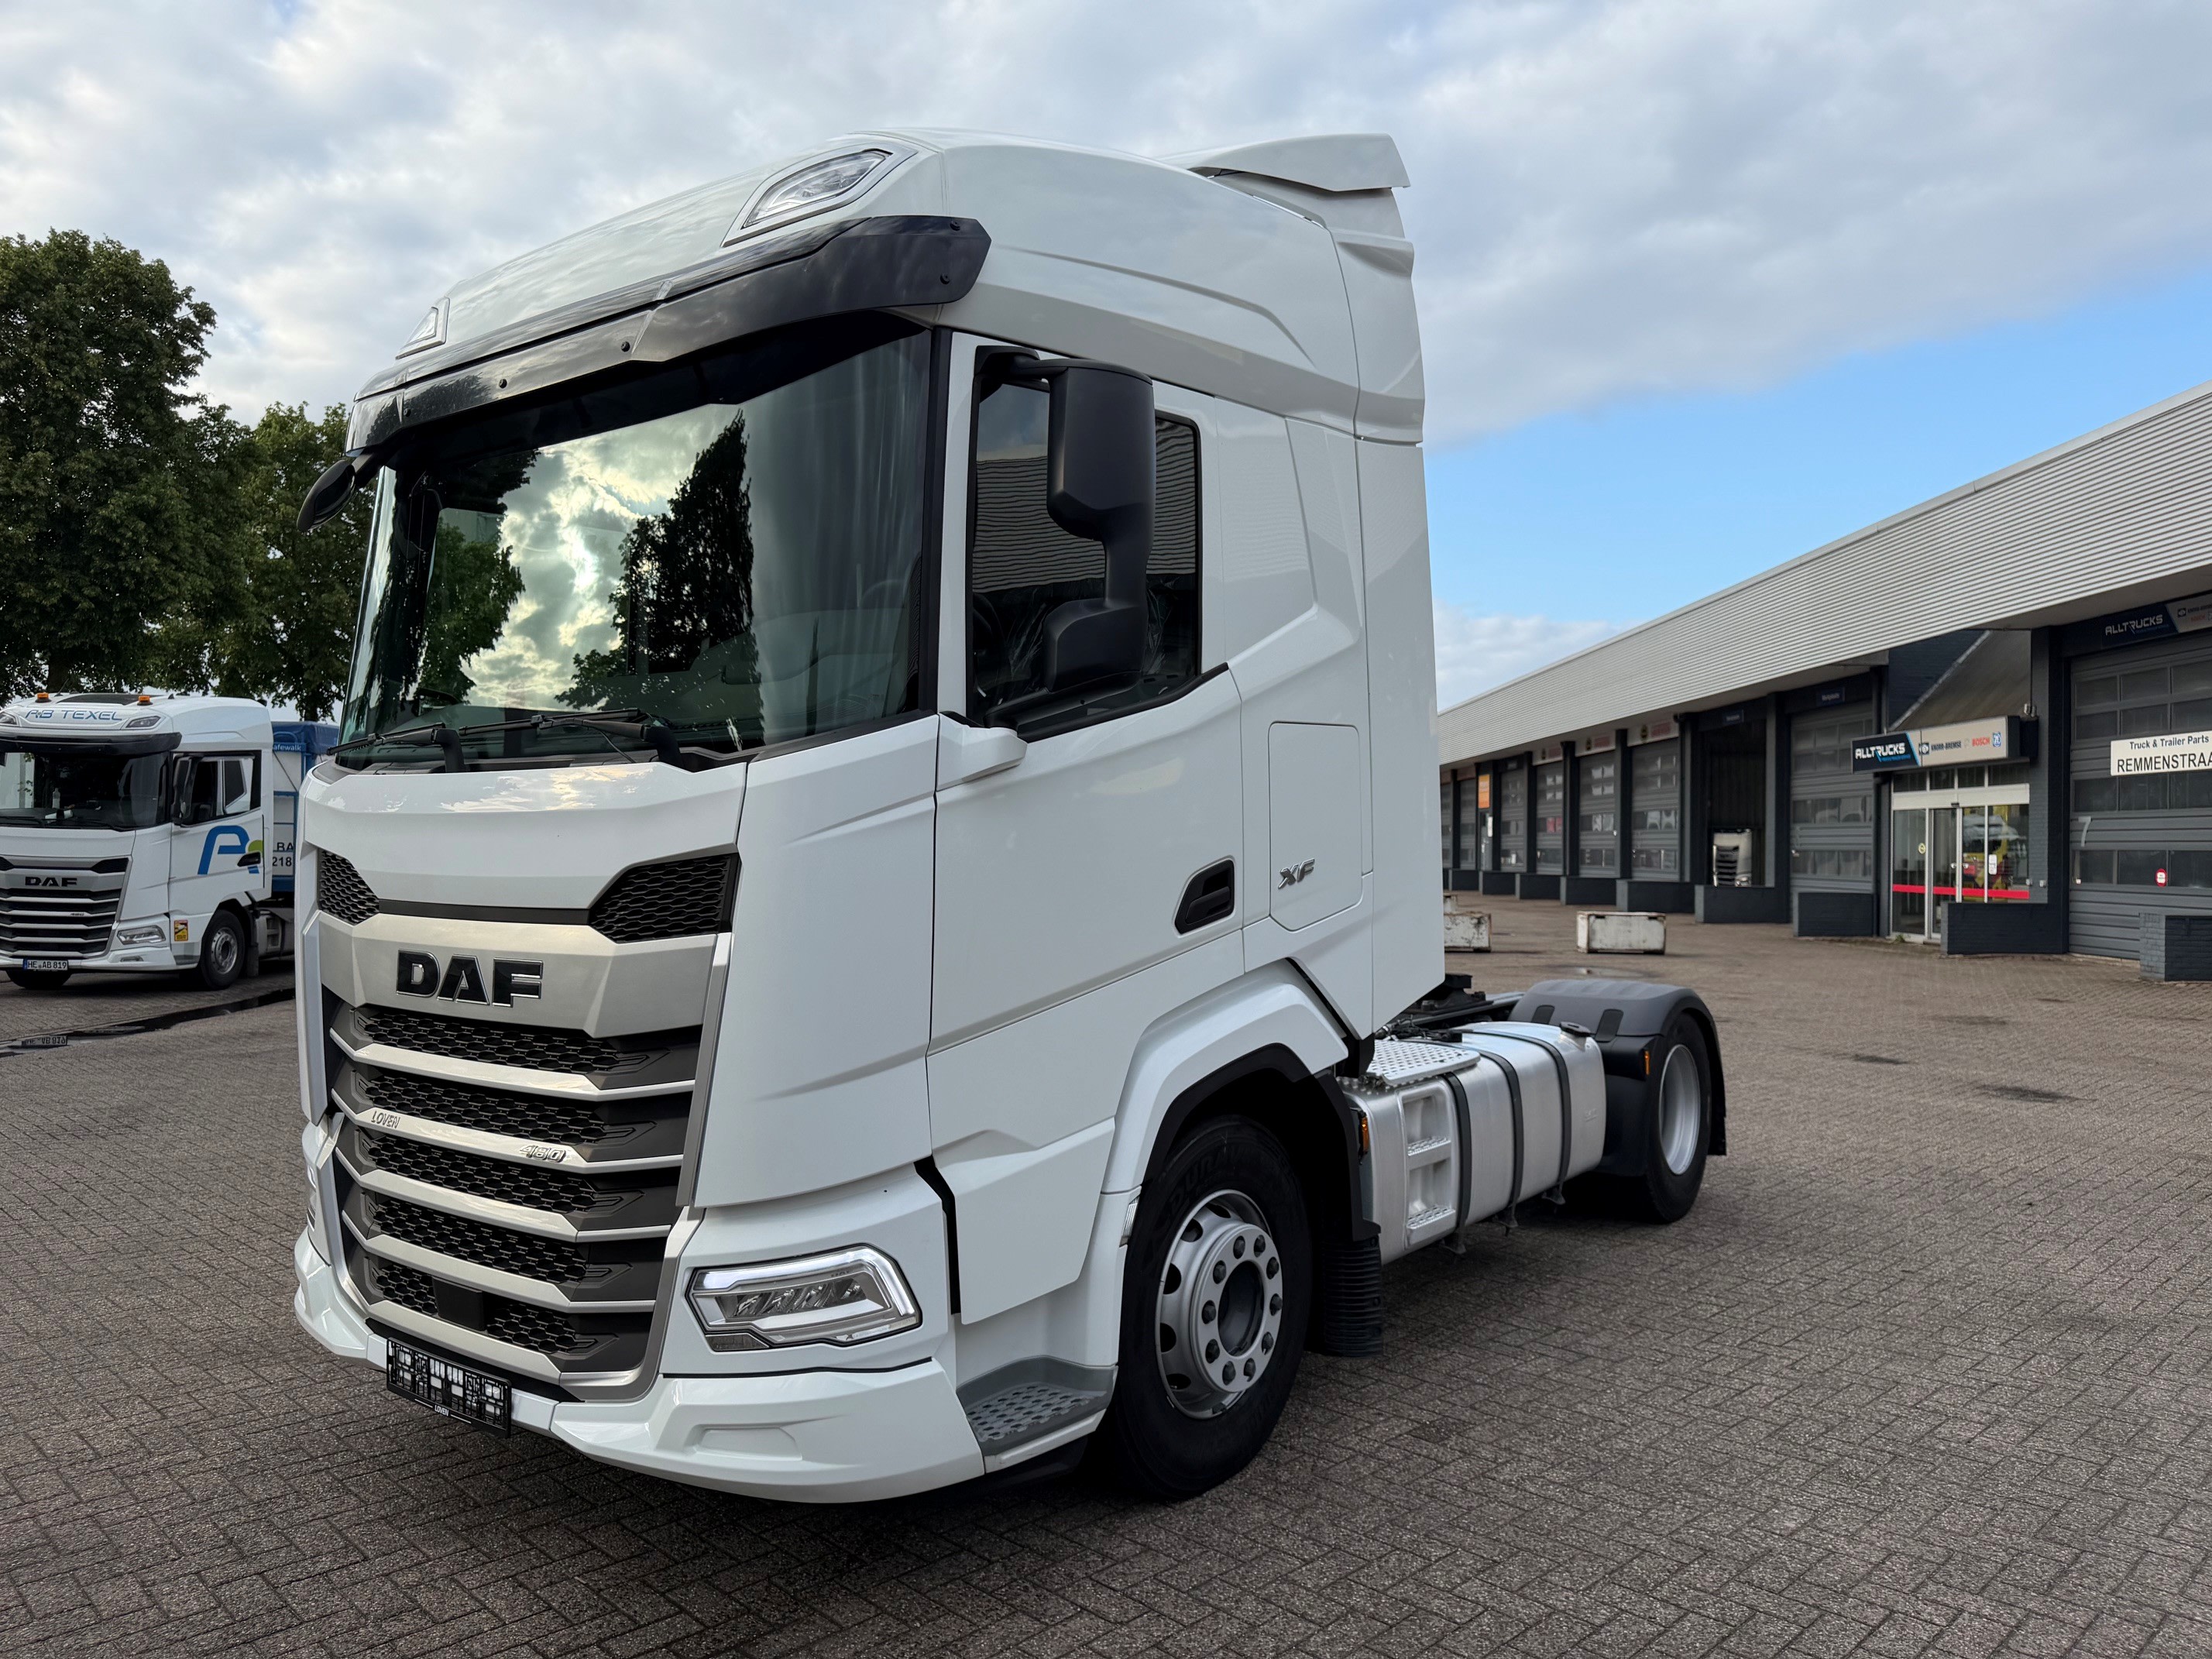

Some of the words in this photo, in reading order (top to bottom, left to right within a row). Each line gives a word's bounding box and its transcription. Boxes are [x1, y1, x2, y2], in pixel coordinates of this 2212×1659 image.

[2105, 614, 2163, 635] ALLTRUCKS
[60, 709, 122, 721] TEXEL
[1855, 742, 1905, 761] ALLTRUCKS
[2130, 740, 2151, 750] Truck
[2152, 739, 2158, 748] &
[2160, 737, 2186, 747] Trailer
[2187, 735, 2209, 744] Parts
[2078, 816, 2091, 847] 7
[25, 876, 77, 888] DAF
[1278, 858, 1315, 890] XF
[396, 949, 544, 1008] DAF
[371, 1110, 401, 1129] LOVEN
[518, 1145, 567, 1163] 480
[434, 1404, 449, 1417] LOVEN
